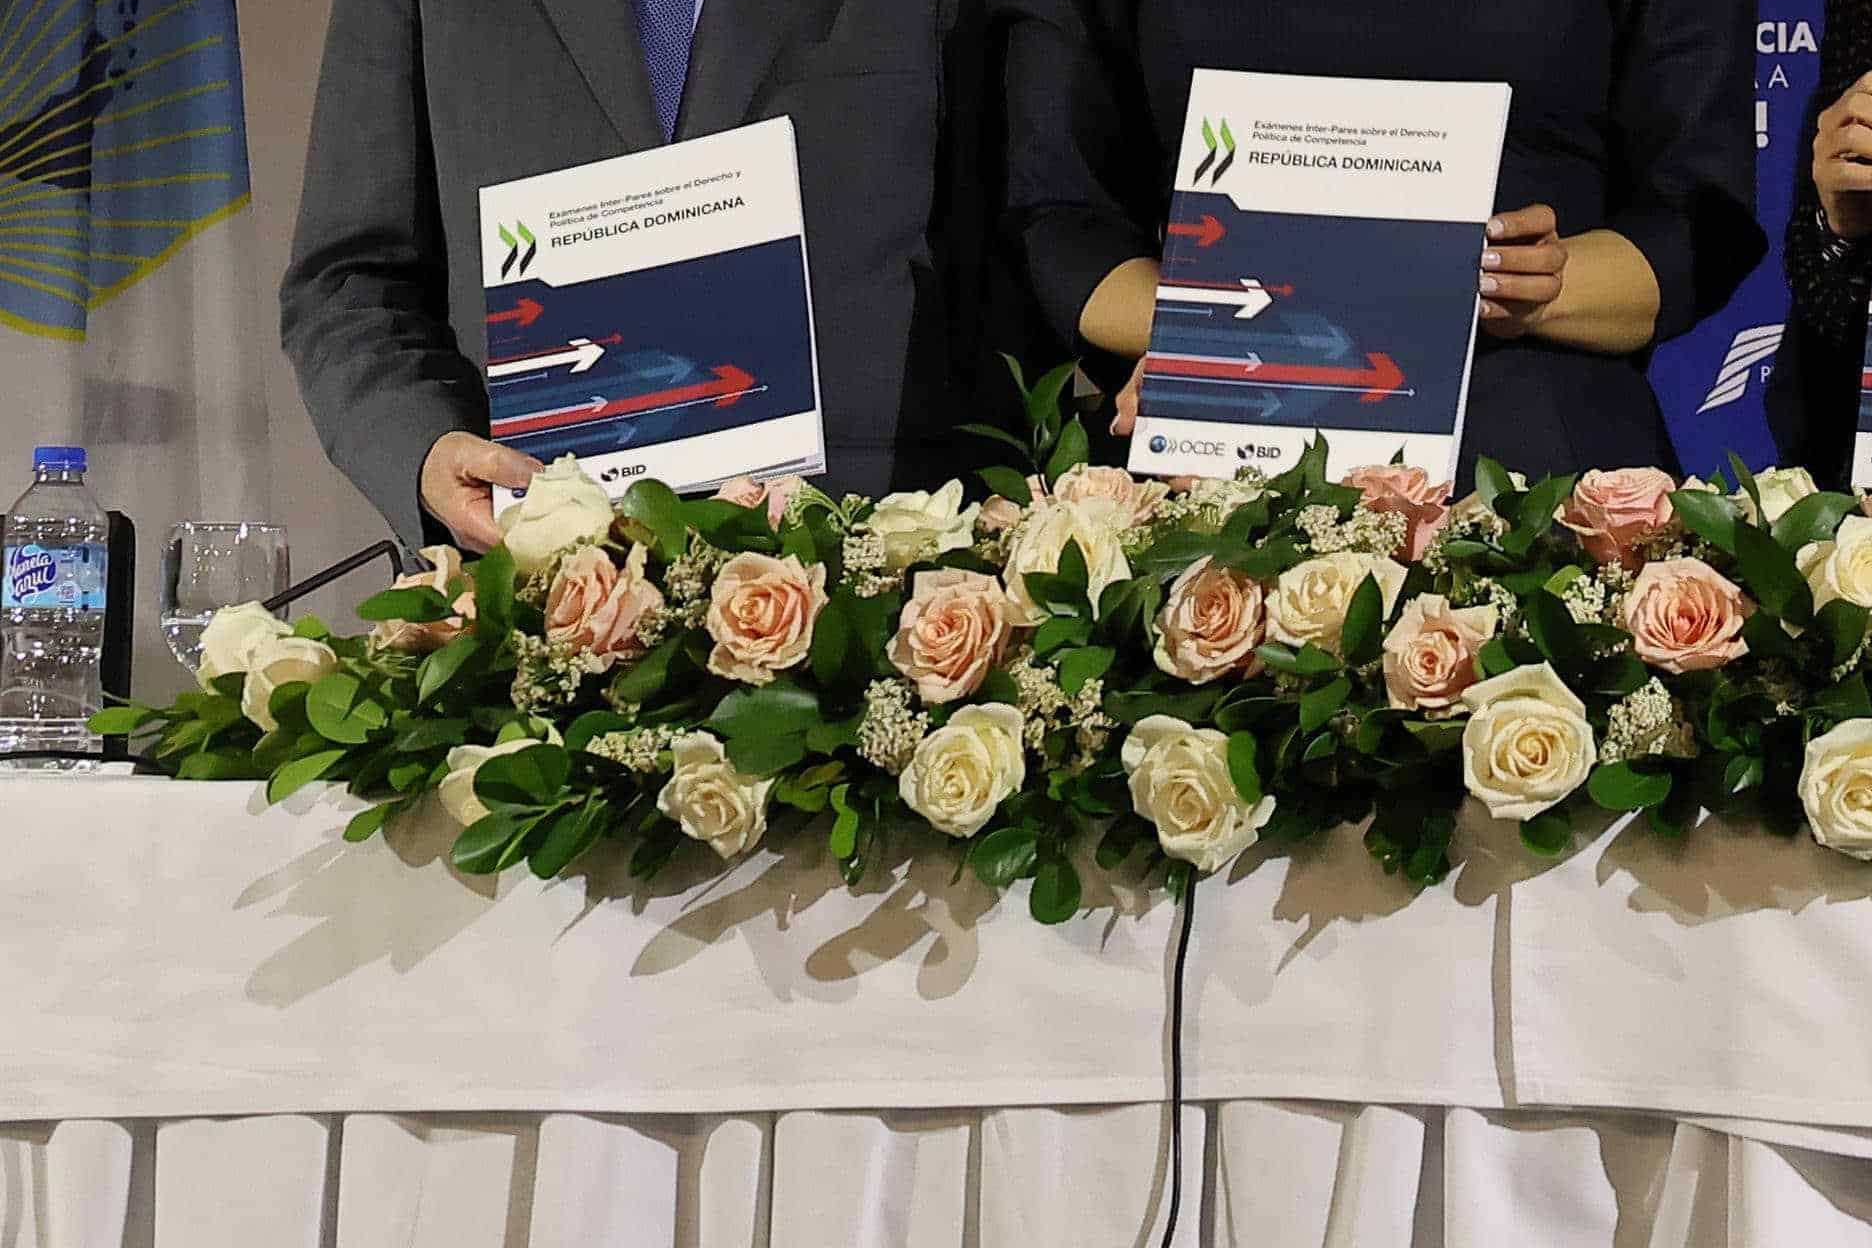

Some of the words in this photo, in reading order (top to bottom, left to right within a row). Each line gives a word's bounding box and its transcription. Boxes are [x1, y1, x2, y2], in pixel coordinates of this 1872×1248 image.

[1769, 65, 1788, 88] A
[1253, 131, 1287, 142] Política
[1290, 133, 1301, 142] de
[1304, 134, 1367, 146] Competencia
[1254, 120, 1303, 132] Exámenes
[1306, 123, 1358, 135] Inter-Pares
[1361, 126, 1387, 136] sobre
[1389, 127, 1398, 137] el
[1400, 128, 1440, 139] Derecho
[1249, 149, 1337, 169] REPÚBLICA
[1342, 156, 1442, 173] DOMINICANA
[550, 203, 597, 219] Exámenes
[600, 191, 652, 210] Inter-Pares
[655, 184, 681, 196] sobre
[683, 181, 692, 190] el
[694, 172, 733, 186] Derecho
[550, 215, 585, 228] Política
[587, 211, 598, 221] de
[601, 198, 664, 217] Competencia
[551, 219, 640, 248] REPÚBLICA
[644, 196, 746, 229] DOMINICANA
[1180, 440, 1225, 456] OCDE
[1256, 446, 1281, 458] BID
[621, 464, 647, 478] BID
